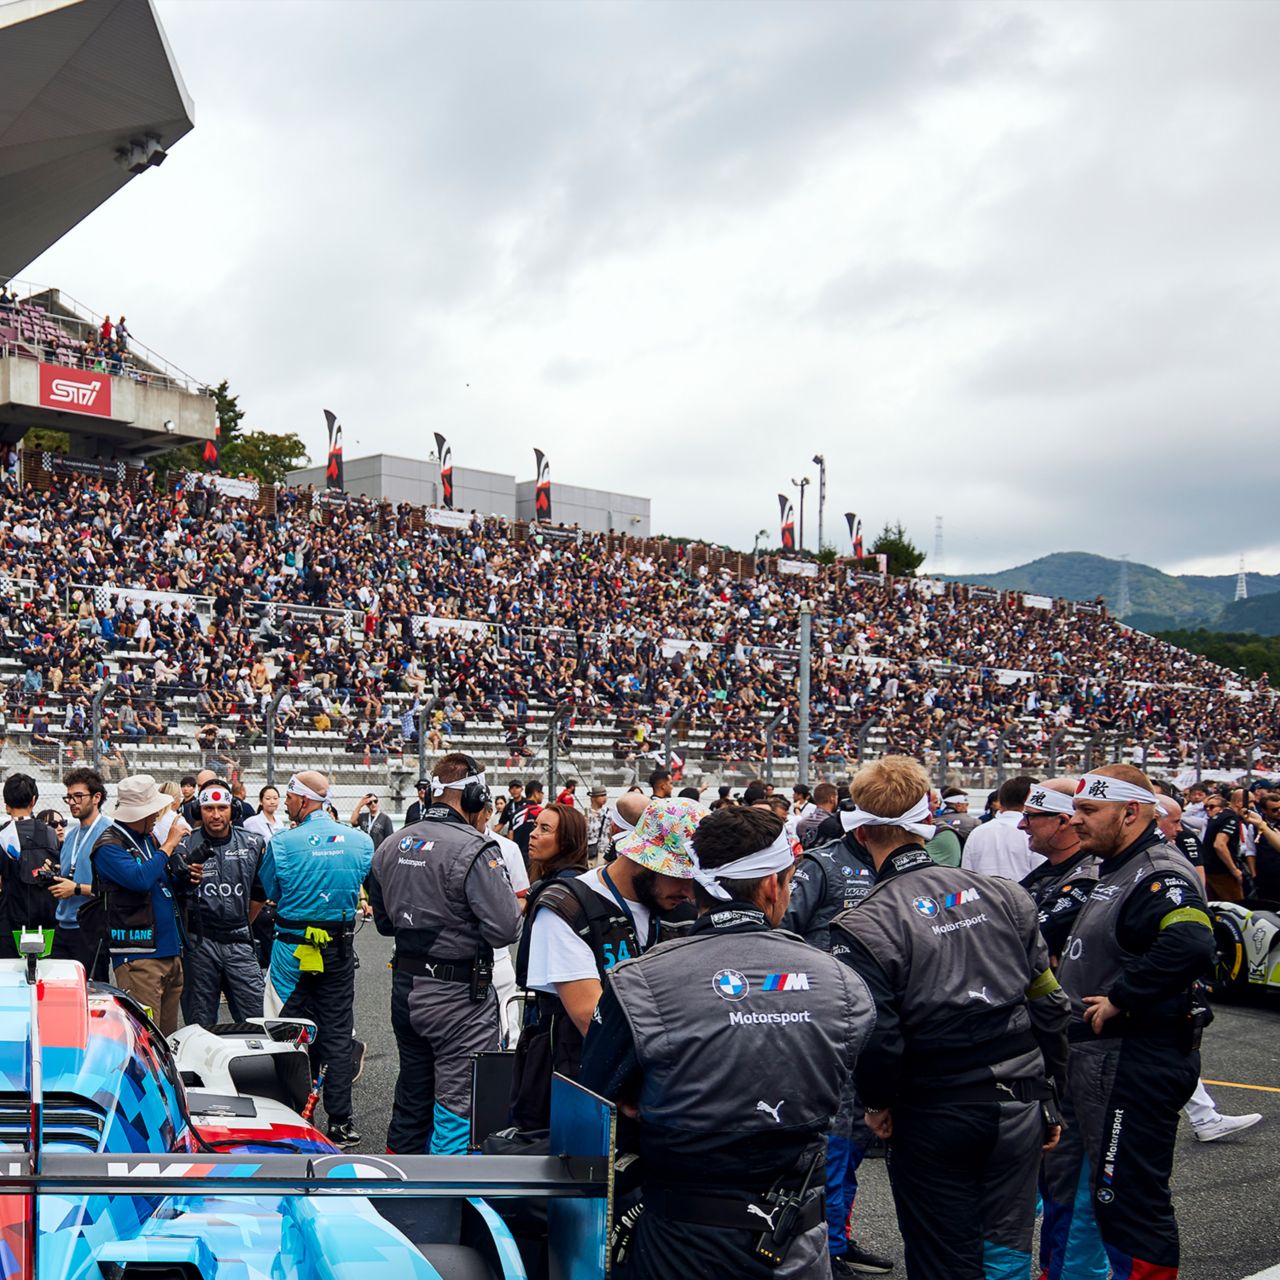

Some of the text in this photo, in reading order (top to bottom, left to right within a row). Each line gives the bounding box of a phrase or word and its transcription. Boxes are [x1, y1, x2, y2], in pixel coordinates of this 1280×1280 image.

[398, 856, 426, 867] Motorsport
[931, 913, 988, 936] Motorsport
[111, 929, 153, 941] PIT LANE
[603, 940, 631, 971] 54
[728, 1010, 811, 1026] Motorsport
[1105, 1108, 1125, 1162] Motorsport
